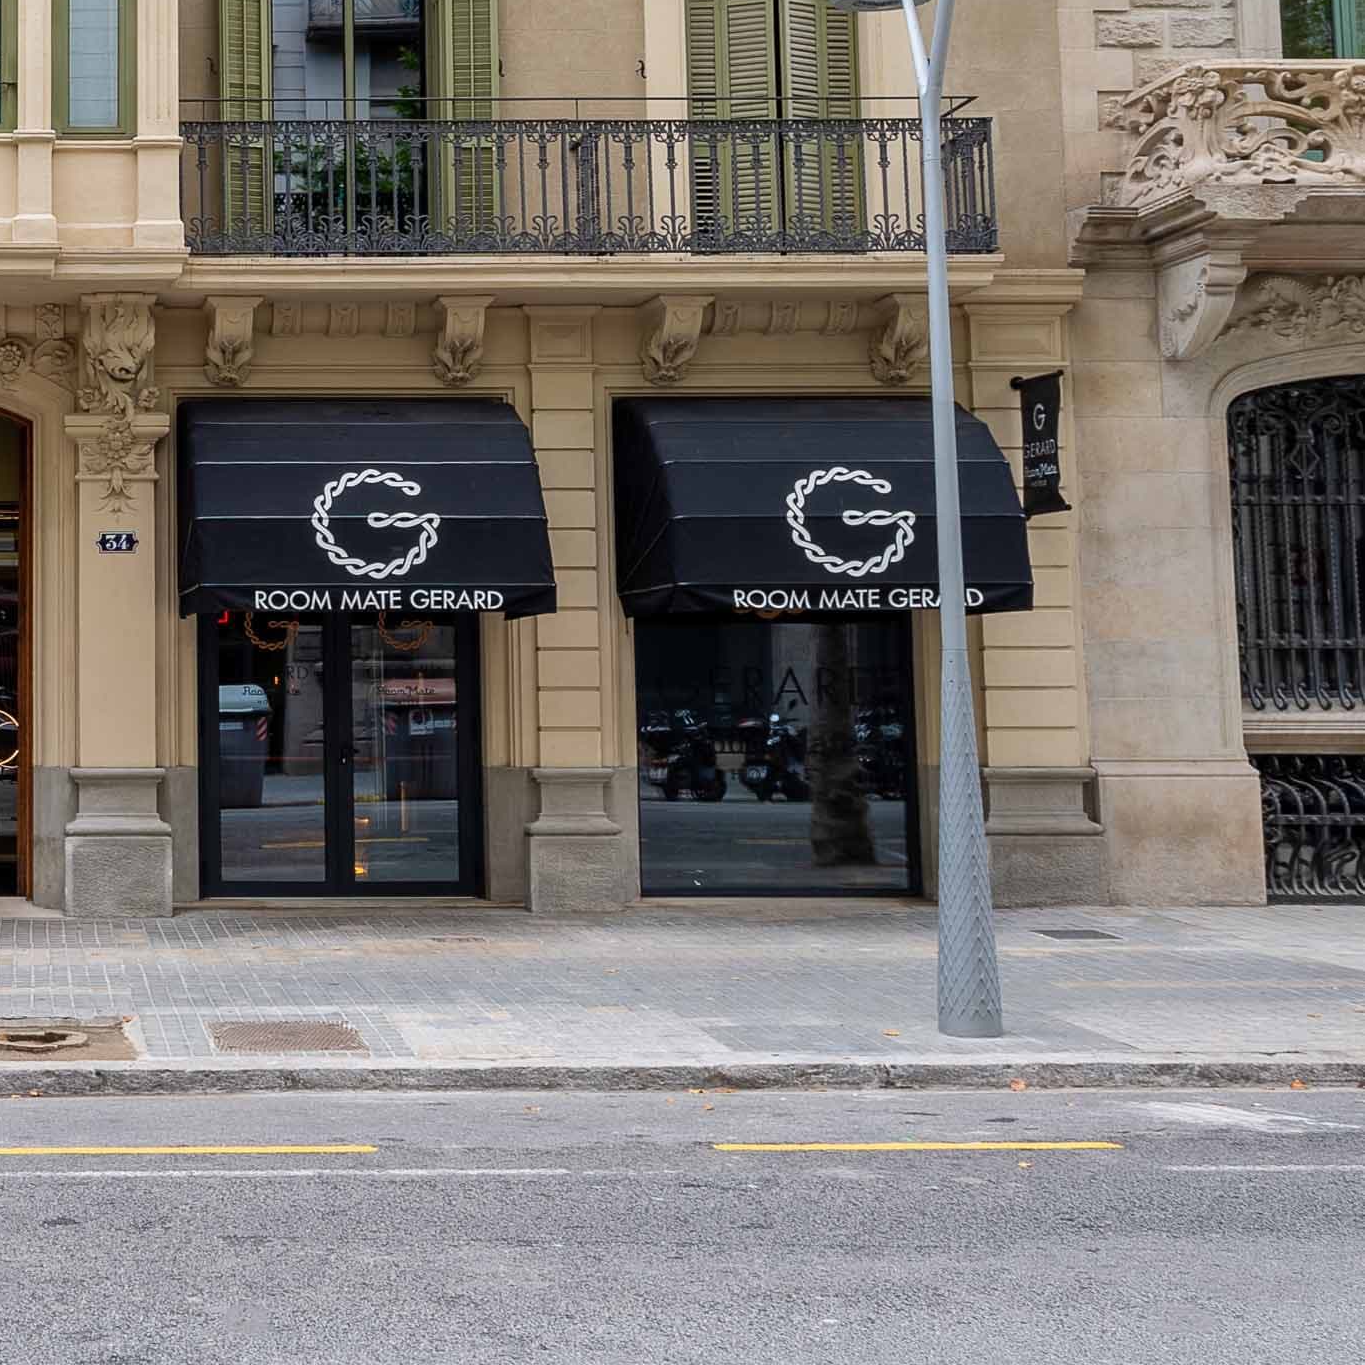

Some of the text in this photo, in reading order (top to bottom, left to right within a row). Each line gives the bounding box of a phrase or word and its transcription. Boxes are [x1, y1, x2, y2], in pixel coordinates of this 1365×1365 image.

[1032, 402, 1047, 430] G
[1023, 438, 1056, 459] GERARD
[311, 469, 441, 579] G
[786, 467, 916, 577] G
[105, 534, 129, 550] 34
[254, 588, 504, 611] ROOM MATE GERARD
[732, 587, 985, 610] ROOM MATE GERD
